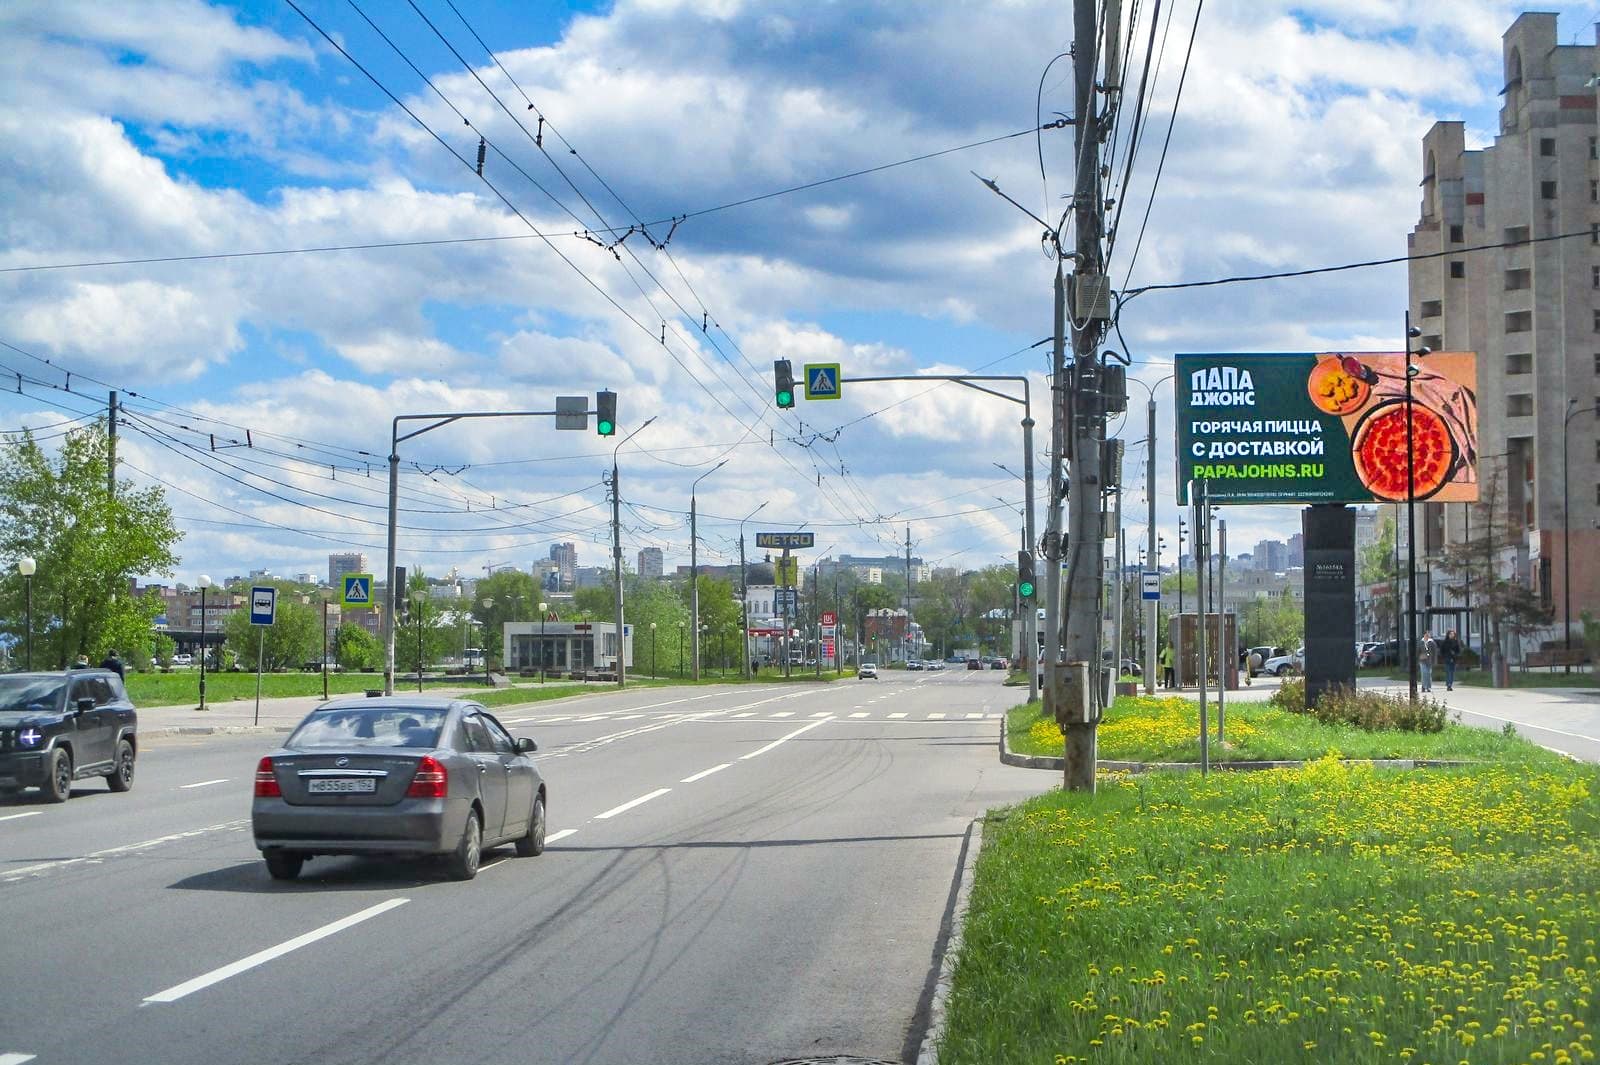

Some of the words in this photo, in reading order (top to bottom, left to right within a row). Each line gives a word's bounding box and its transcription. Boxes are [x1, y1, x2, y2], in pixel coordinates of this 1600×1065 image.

[1191, 366, 1254, 391] ПАПА
[1190, 391, 1255, 406] ДЖОНС
[1192, 421, 1262, 434] ГОРЯЧАЯ
[1265, 420, 1322, 434] ПИЦЦА
[1192, 441, 1205, 456] С
[1208, 437, 1324, 459] ДОСТАВКОЙ
[1193, 463, 1324, 479] PAPAJOHNS.RU
[758, 534, 811, 545] METRO
